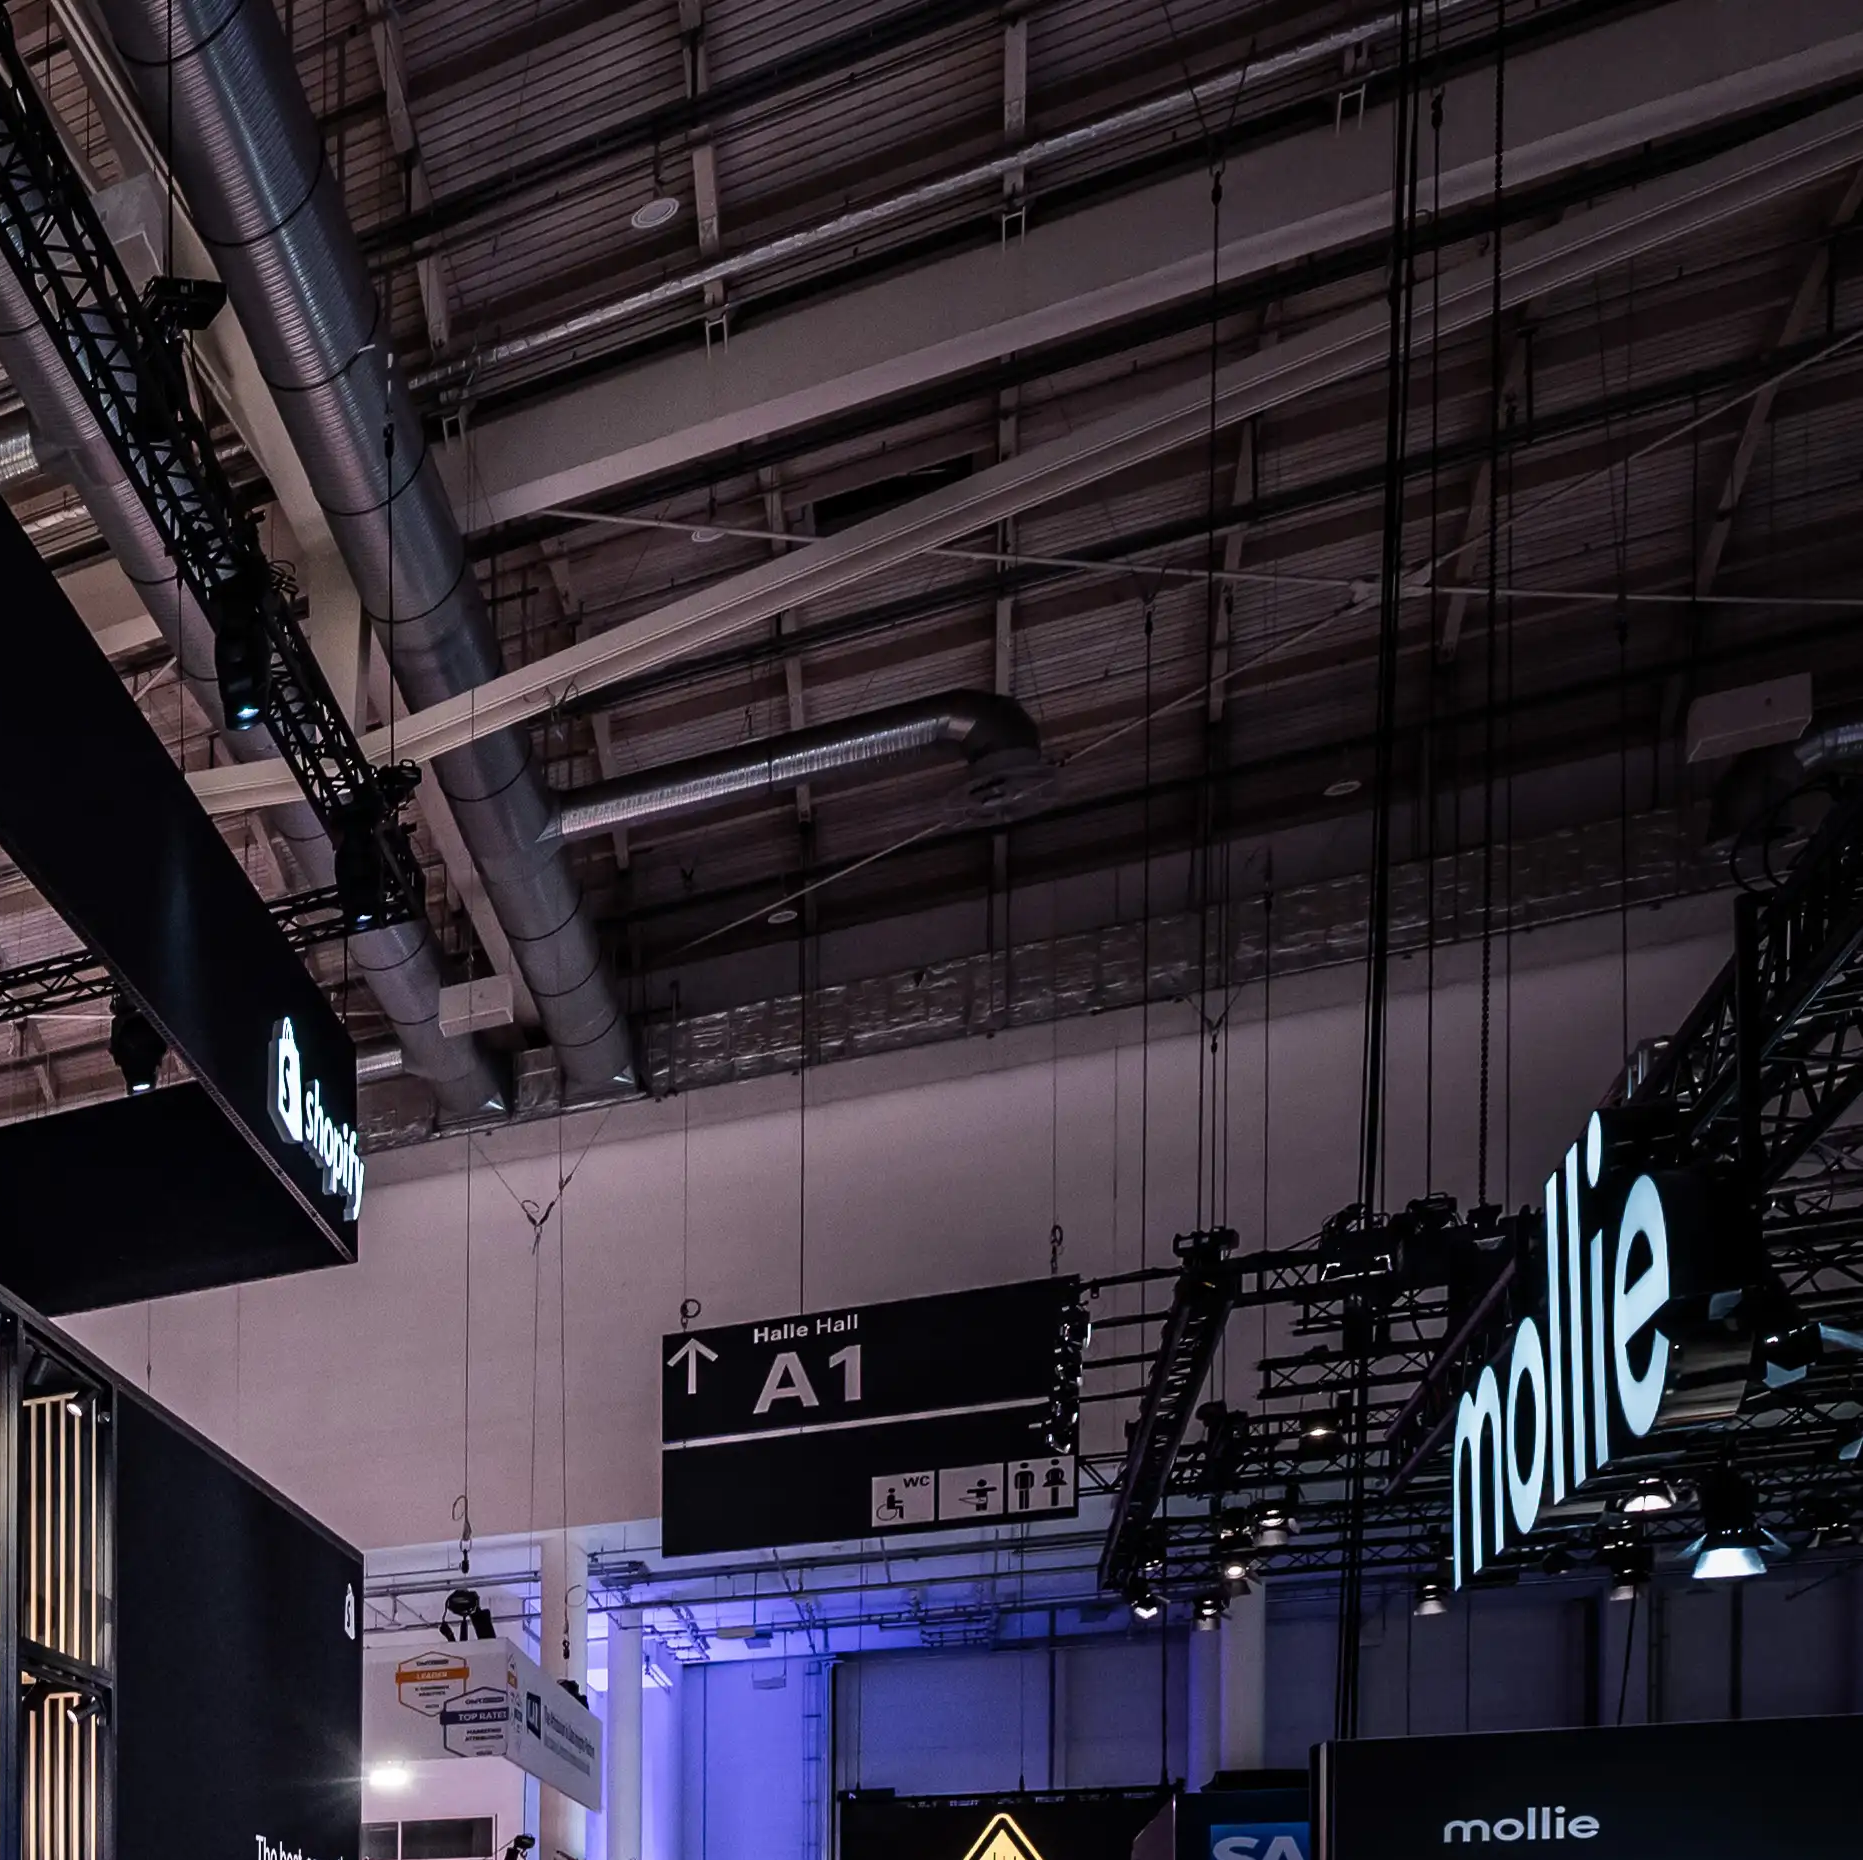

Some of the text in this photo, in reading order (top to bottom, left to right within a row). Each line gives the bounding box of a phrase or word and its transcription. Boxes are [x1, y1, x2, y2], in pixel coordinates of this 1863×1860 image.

[304, 1080, 364, 1221] shopify
[753, 1313, 859, 1345] Halle Hall
[1453, 1110, 1671, 1592] mollie
[753, 1344, 862, 1415] A1
[903, 1474, 931, 1489] WC
[458, 1713, 478, 1721] TOP
[1443, 1805, 1600, 1843] mollie
